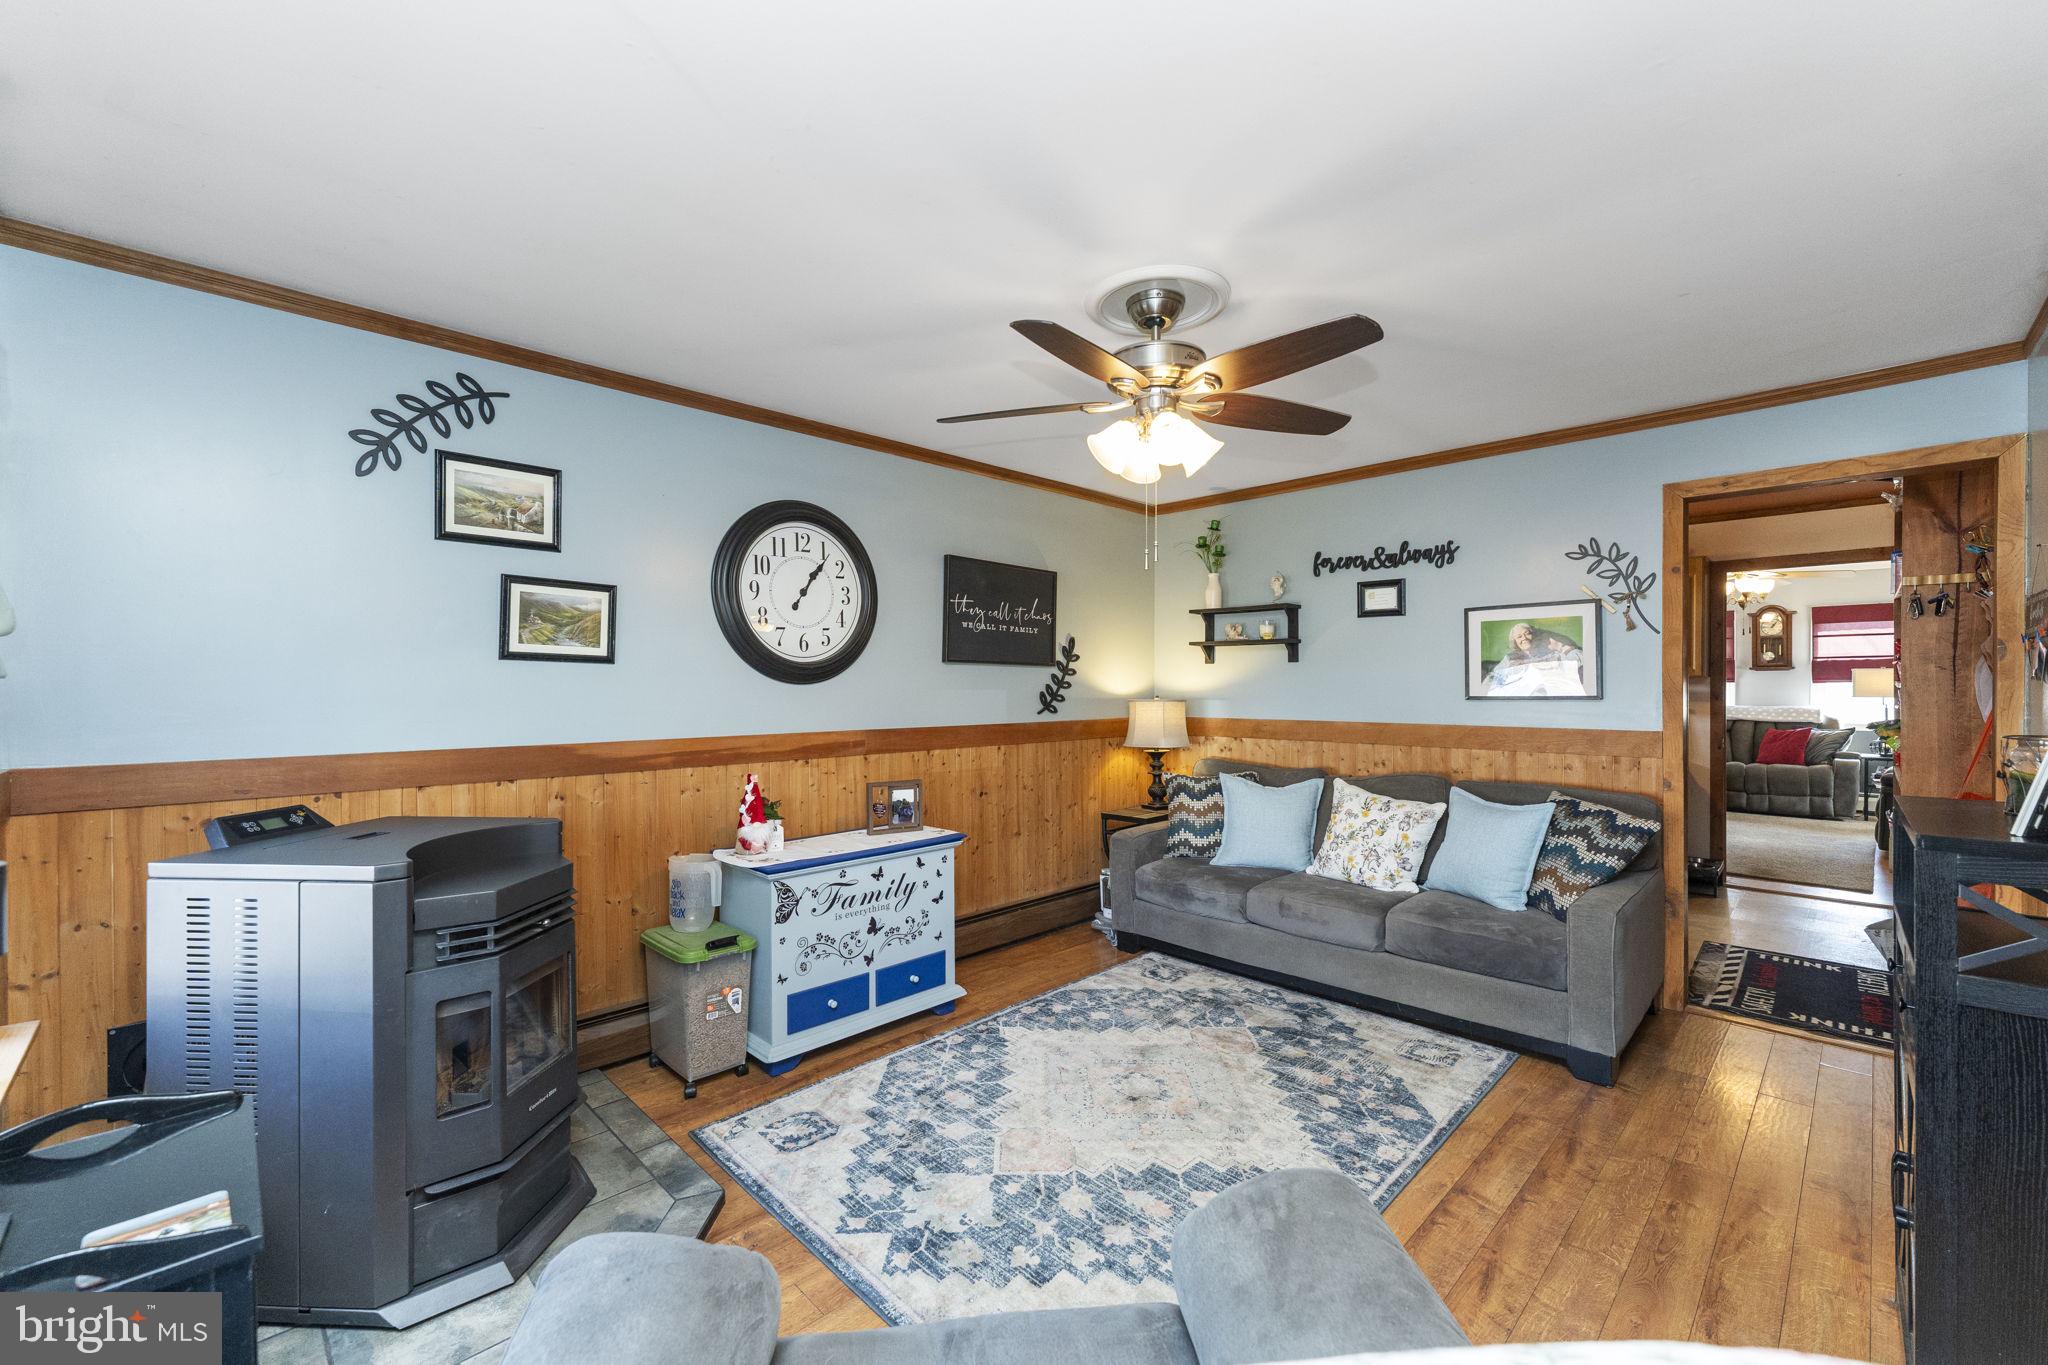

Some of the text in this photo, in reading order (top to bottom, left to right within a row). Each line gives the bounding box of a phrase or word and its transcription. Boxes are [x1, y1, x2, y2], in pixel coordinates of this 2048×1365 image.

[772, 536, 786, 557] 11
[794, 532, 811, 553] 12
[820, 541, 826, 560] 1
[754, 554, 771, 576] 10
[835, 560, 845, 579] 2
[749, 580, 760, 600] 9
[841, 586, 851, 605] 3
[758, 606, 768, 625] 8
[836, 609, 847, 628] 4
[950, 593, 1054, 632] they call it chaos
[775, 627, 786, 647] 7
[821, 628, 831, 646] 5
[961, 621, 1039, 635] WE CALL IT FAMILY
[799, 633, 809, 652] 6
[811, 872, 918, 917] Family
[844, 903, 891, 918] everything
